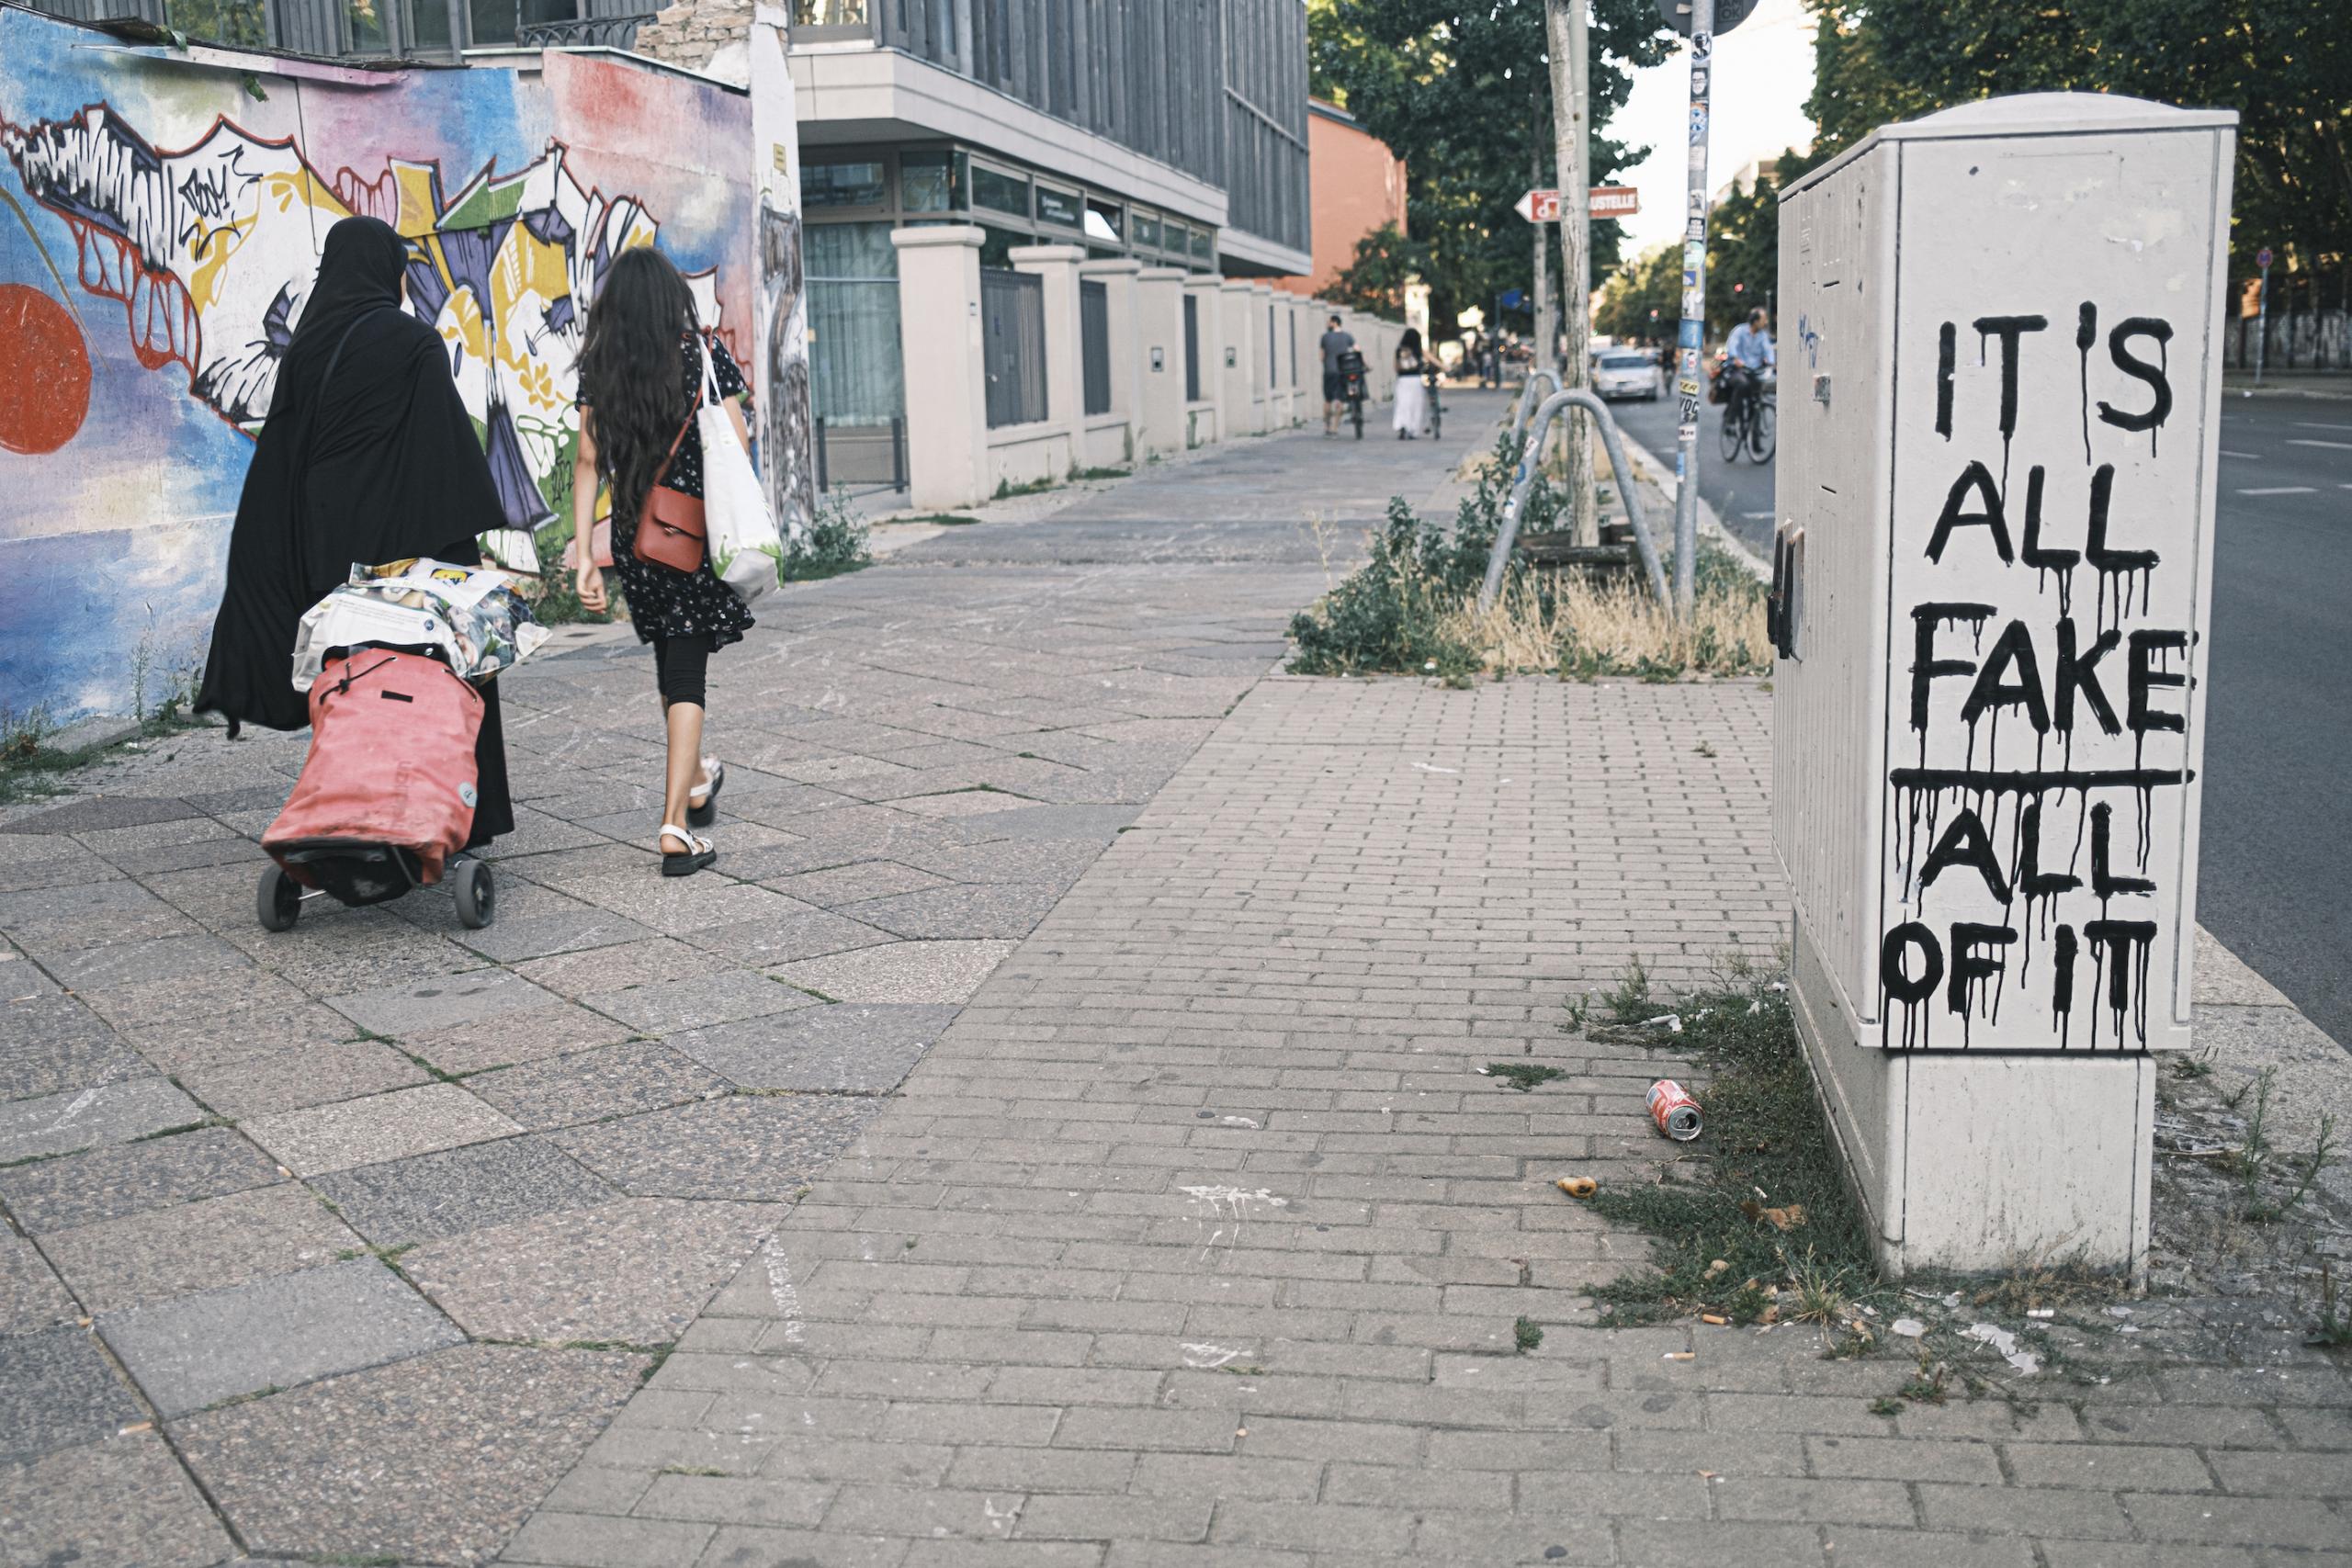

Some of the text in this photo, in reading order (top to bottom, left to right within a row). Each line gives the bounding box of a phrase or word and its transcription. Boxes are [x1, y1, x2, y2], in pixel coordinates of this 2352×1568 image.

[1589, 193, 1636, 210] USTELLE
[1935, 301, 2174, 443] IT'S
[1925, 460, 2162, 571] ALL
[1908, 602, 2199, 739] FAKE
[1917, 801, 2157, 906] ALL
[1882, 919, 2158, 1014] OF IT
